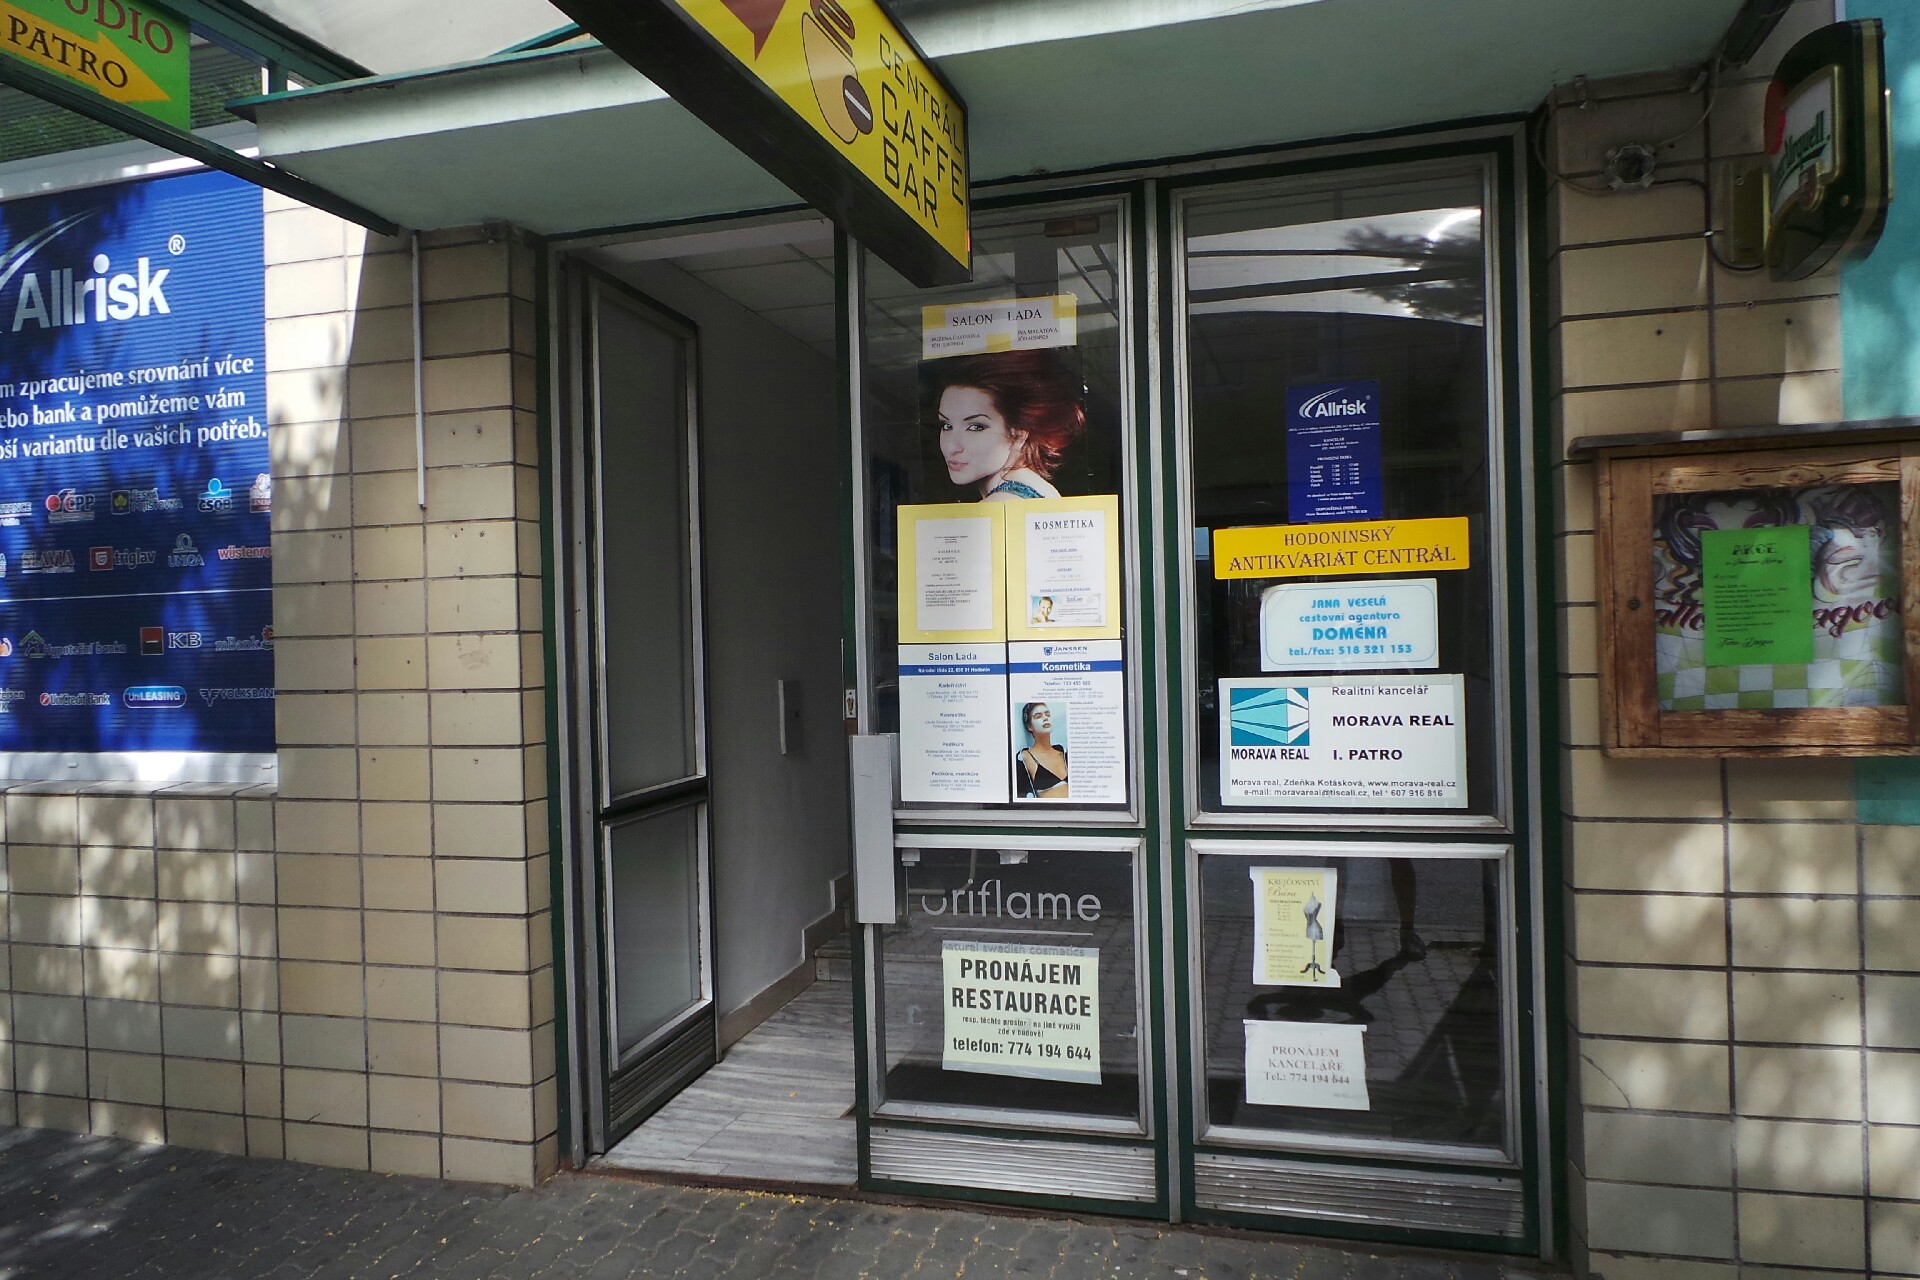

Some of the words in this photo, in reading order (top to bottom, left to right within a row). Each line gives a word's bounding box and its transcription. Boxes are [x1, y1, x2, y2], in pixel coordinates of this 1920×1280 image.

[7, 14, 128, 88] PATRO
[879, 32, 962, 156] CENTRÁL
[881, 81, 964, 206] CAFFE
[883, 135, 938, 228] BAR
[952, 313, 993, 327] SALON
[1007, 308, 1042, 322] LADA
[20, 368, 124, 400] zpracujeme
[129, 354, 208, 385] srovnání
[215, 353, 254, 376] více
[33, 401, 76, 425] bank
[81, 407, 92, 421] a
[97, 394, 199, 425] pomůžeme
[205, 387, 245, 408] vám
[1315, 399, 1367, 418] Allrisk
[23, 434, 95, 457] variantu
[101, 428, 128, 450] dle
[135, 422, 191, 448] vašich
[198, 415, 267, 447] potřeb.
[1034, 519, 1095, 531] KOSMETIKA
[1284, 525, 1396, 546] HODONÍNSKÝ
[113, 549, 156, 569] triglav
[168, 553, 205, 568] UNIQA
[1228, 549, 1358, 572] ANTIKVARIÁT
[1363, 545, 1457, 565] CENTRÁL
[1311, 599, 1340, 609] JANA
[1347, 595, 1387, 608] VESELÁ
[1299, 612, 1345, 622] cestovní
[1348, 612, 1400, 623] agentura
[168, 632, 202, 649] KB
[1312, 624, 1387, 641] DOMÉNA
[928, 652, 953, 661] Salon
[956, 651, 977, 660] Lada
[1288, 647, 1334, 657] tel./fax:
[1338, 645, 1360, 655] 518
[1364, 645, 1384, 654] 321
[1391, 644, 1413, 654] 153
[1041, 662, 1091, 672] Kosmetika
[128, 690, 181, 702] UniLEASING
[1332, 686, 1375, 696] Realitní
[1378, 685, 1429, 695] kancelář
[1332, 715, 1404, 727] MORAVA
[1409, 715, 1455, 727] REAL
[1231, 748, 1277, 760] MORAVA
[1280, 748, 1310, 760] REAL
[1349, 749, 1403, 760] PATRO
[1263, 779, 1281, 787] real,
[1368, 779, 1456, 787] www.morava-real.cz
[960, 958, 1081, 986] PRONÁJEM
[952, 987, 1092, 1017] RESTAURACE
[953, 1037, 1003, 1054] telefon:
[1008, 1041, 1032, 1056] 774
[1038, 1044, 1061, 1059] 194
[1066, 1045, 1092, 1061] 644
[1272, 1045, 1339, 1058] PRONÁJEM
[1268, 1058, 1344, 1071] KANCELÁŘE
[1290, 1073, 1307, 1082] 774
[1312, 1074, 1329, 1083] 194
[1332, 1073, 1350, 1084] 644
